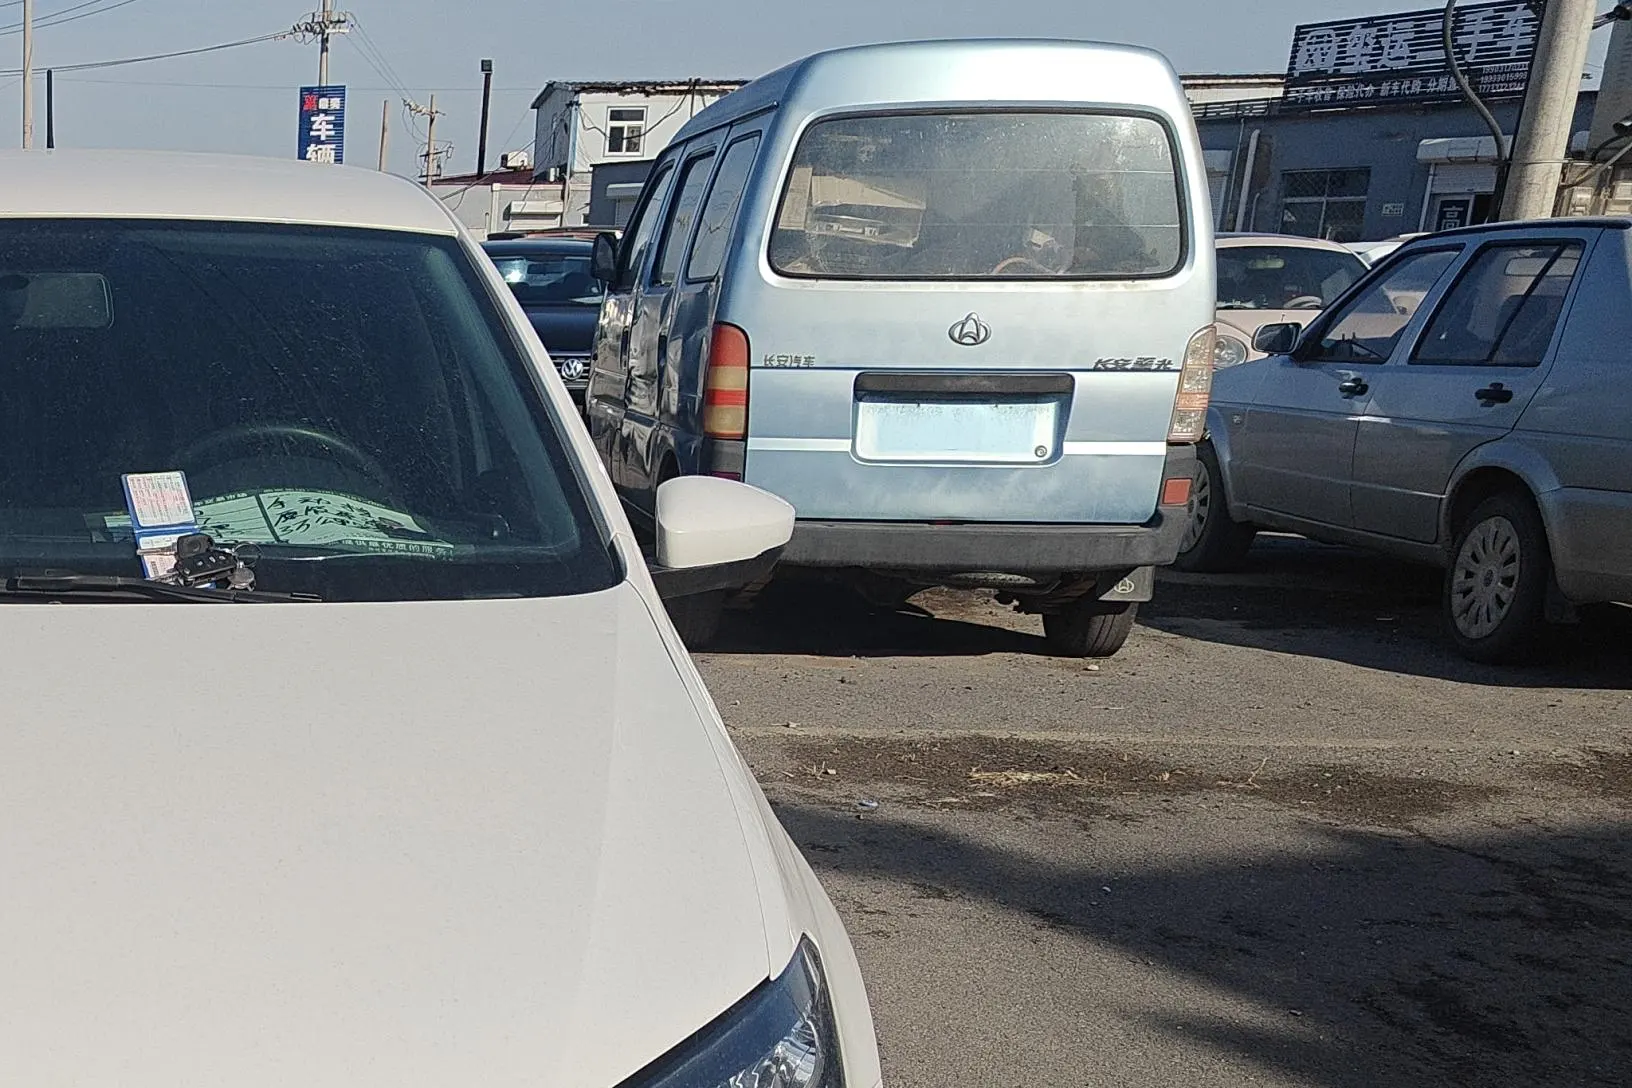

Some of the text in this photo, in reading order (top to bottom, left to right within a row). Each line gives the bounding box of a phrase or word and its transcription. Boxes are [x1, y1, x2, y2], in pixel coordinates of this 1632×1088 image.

[305, 112, 336, 164] 车辆
[1440, 204, 1465, 231] 高
[764, 354, 816, 368] 长安汽车
